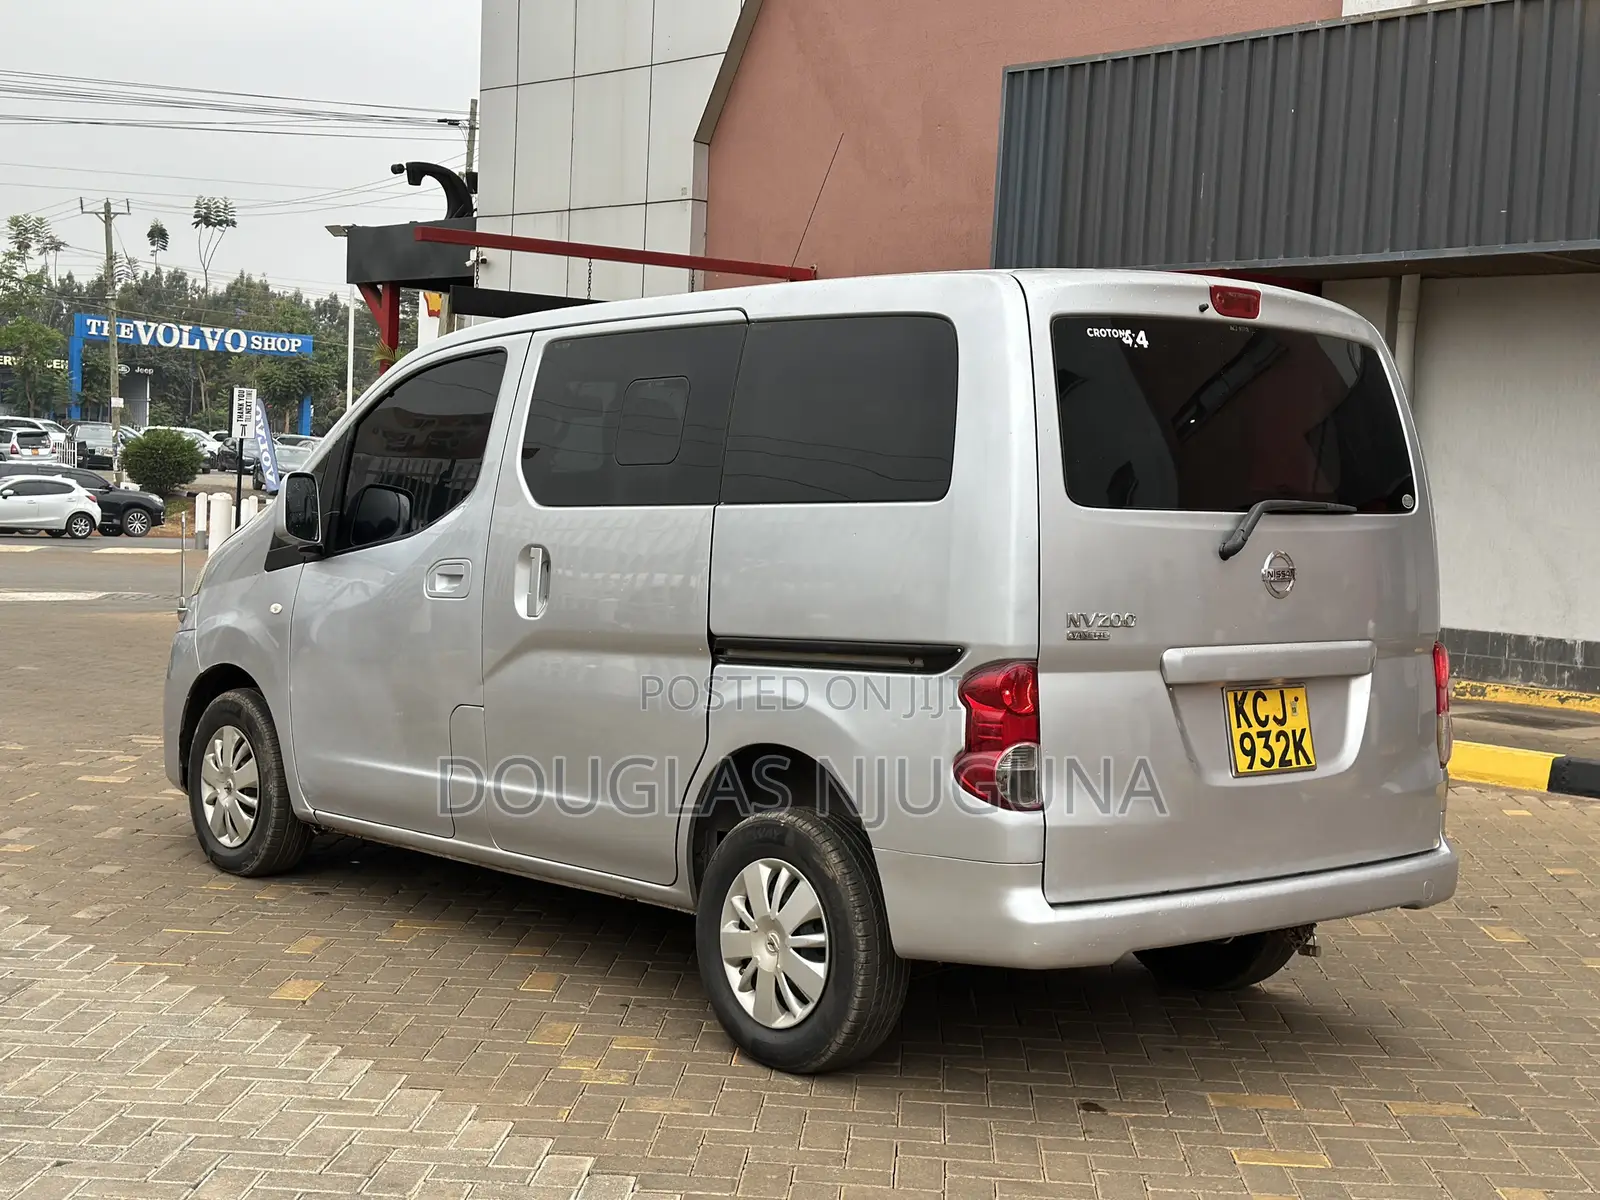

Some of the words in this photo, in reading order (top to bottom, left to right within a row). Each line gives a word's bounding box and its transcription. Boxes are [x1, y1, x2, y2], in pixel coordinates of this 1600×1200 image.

[133, 320, 247, 353] VOLVO
[250, 335, 303, 352] SHOP
[134, 366, 154, 375] Jeep
[256, 405, 277, 485] VOLVO
[1267, 569, 1295, 580] NISSAN
[1066, 612, 1136, 628] NV200
[1233, 690, 1287, 728] KCJ
[1239, 728, 1312, 770] 932K
